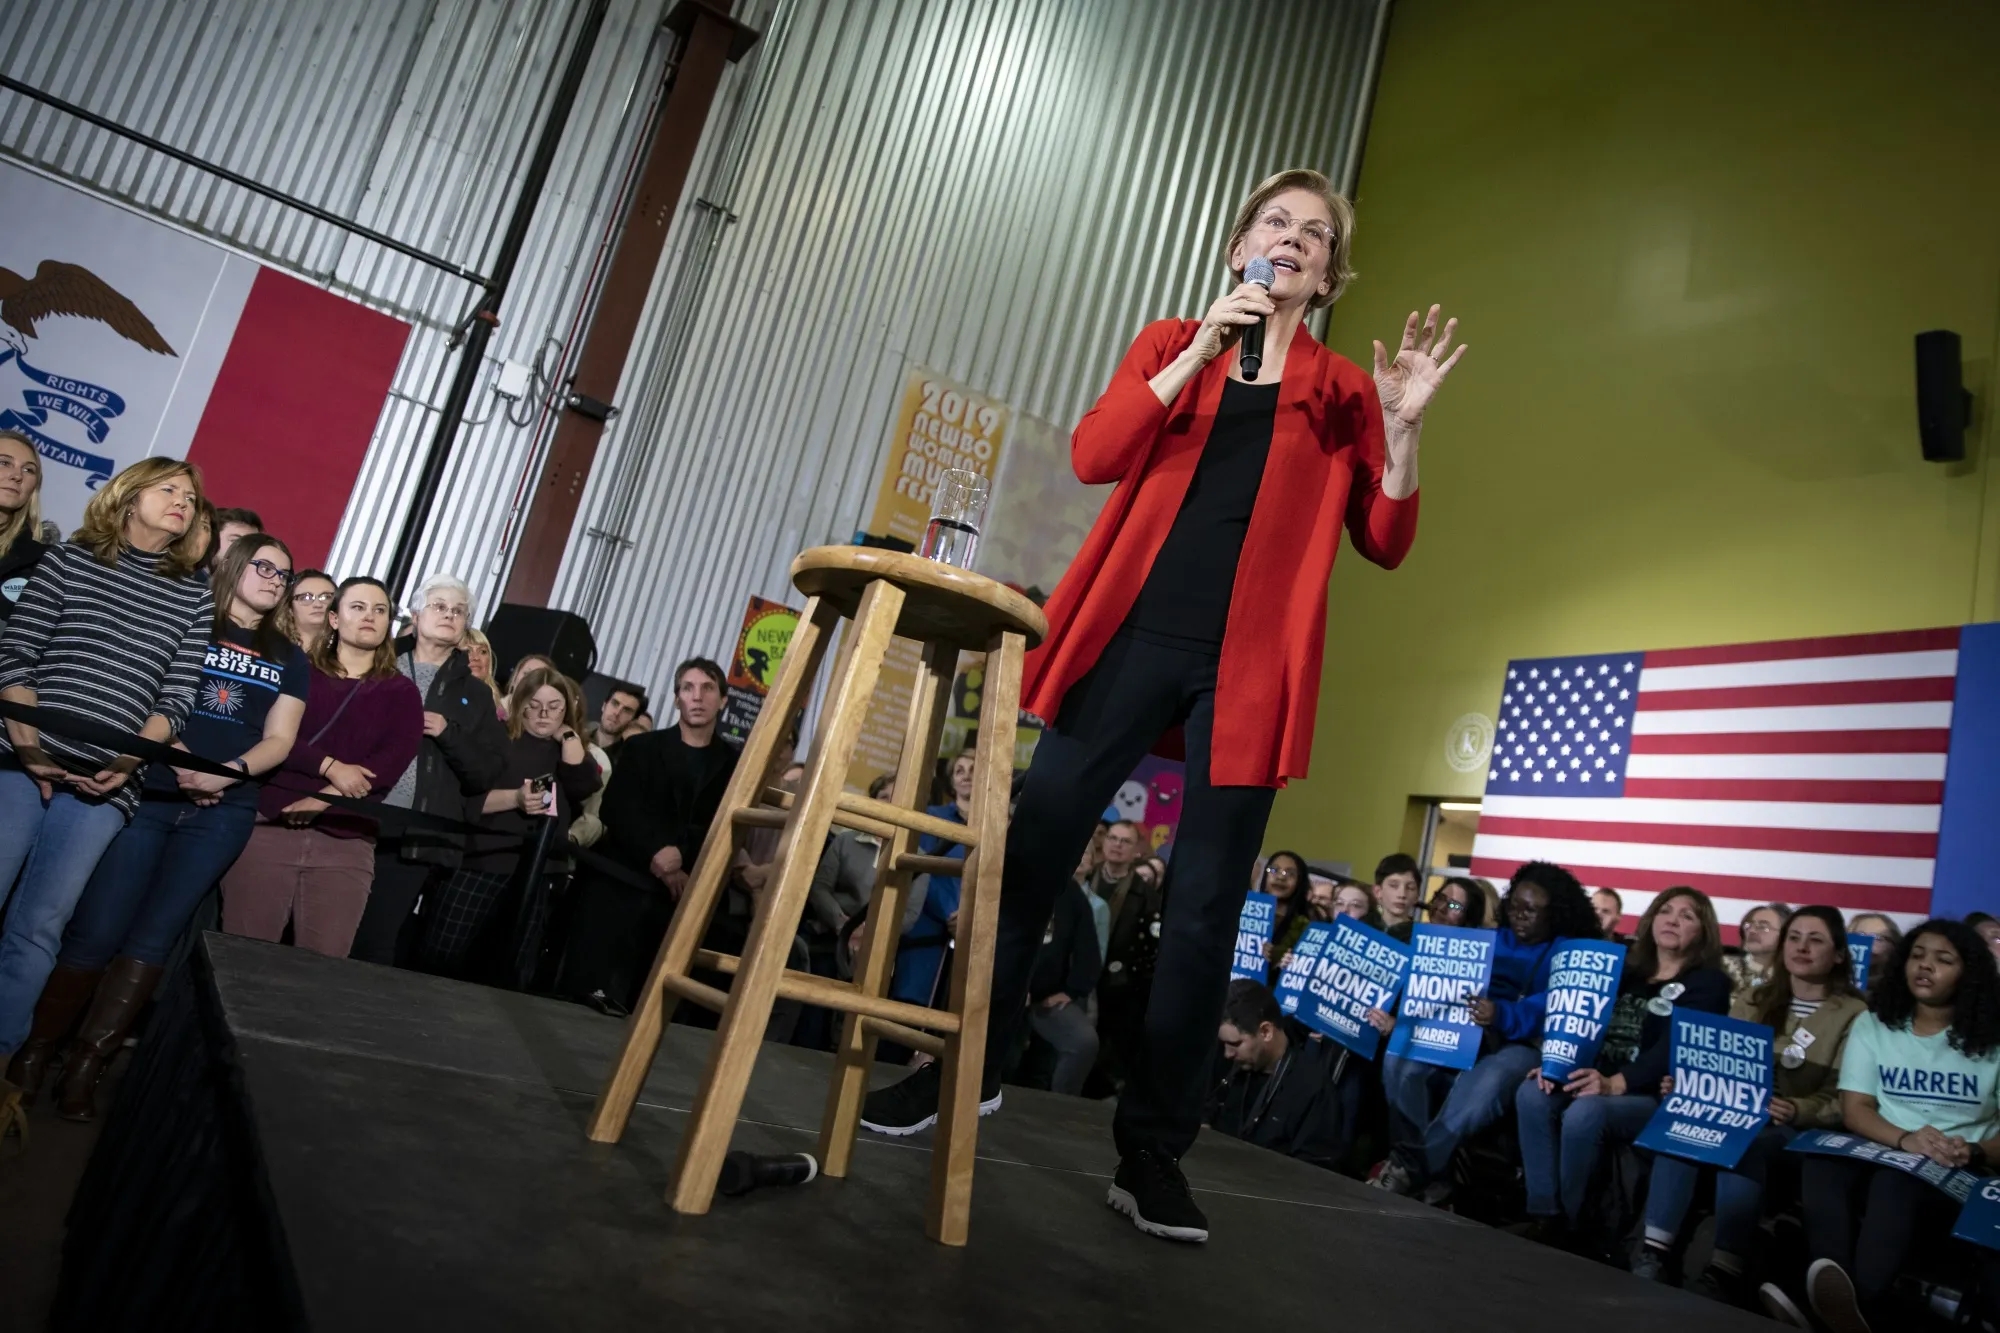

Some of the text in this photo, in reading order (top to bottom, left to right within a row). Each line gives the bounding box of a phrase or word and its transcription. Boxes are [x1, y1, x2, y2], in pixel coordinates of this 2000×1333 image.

[46, 375, 109, 403] RIGHTS
[38, 394, 99, 430] WE WILL
[920, 381, 999, 438] 2019
[204, 652, 281, 685] RSISTED.
[220, 647, 252, 664] SHE
[1235, 931, 1268, 956] NEY
[1335, 924, 1368, 953] THE
[1365, 940, 1409, 972] BEST
[1416, 934, 1490, 960] THE BEST
[1241, 955, 1266, 973] BUY
[1324, 941, 1400, 989] PRESIDENT
[1411, 955, 1487, 980] PRESIDENT
[1569, 949, 1618, 973] BEST
[1315, 957, 1392, 1009] MONEY
[1407, 973, 1485, 1006] MONEY
[1308, 978, 1352, 1010] CAN'T
[1350, 1003, 1369, 1023] BU
[1404, 999, 1476, 1027] CAN'T BU
[1546, 988, 1610, 1020] ONEY
[1317, 1003, 1361, 1034] WARREN
[1564, 1015, 1603, 1041] BUY
[1413, 1025, 1460, 1046] WARREN
[1677, 1020, 1717, 1049] THE
[1719, 1029, 1768, 1061] BEST
[1676, 1045, 1768, 1083] PRESIDENT
[1674, 1066, 1768, 1115] MONEY
[1879, 1064, 1979, 1097] WARREN
[1665, 1096, 1762, 1130] CAN'T BUY
[1669, 1120, 1727, 1144] WARREN
